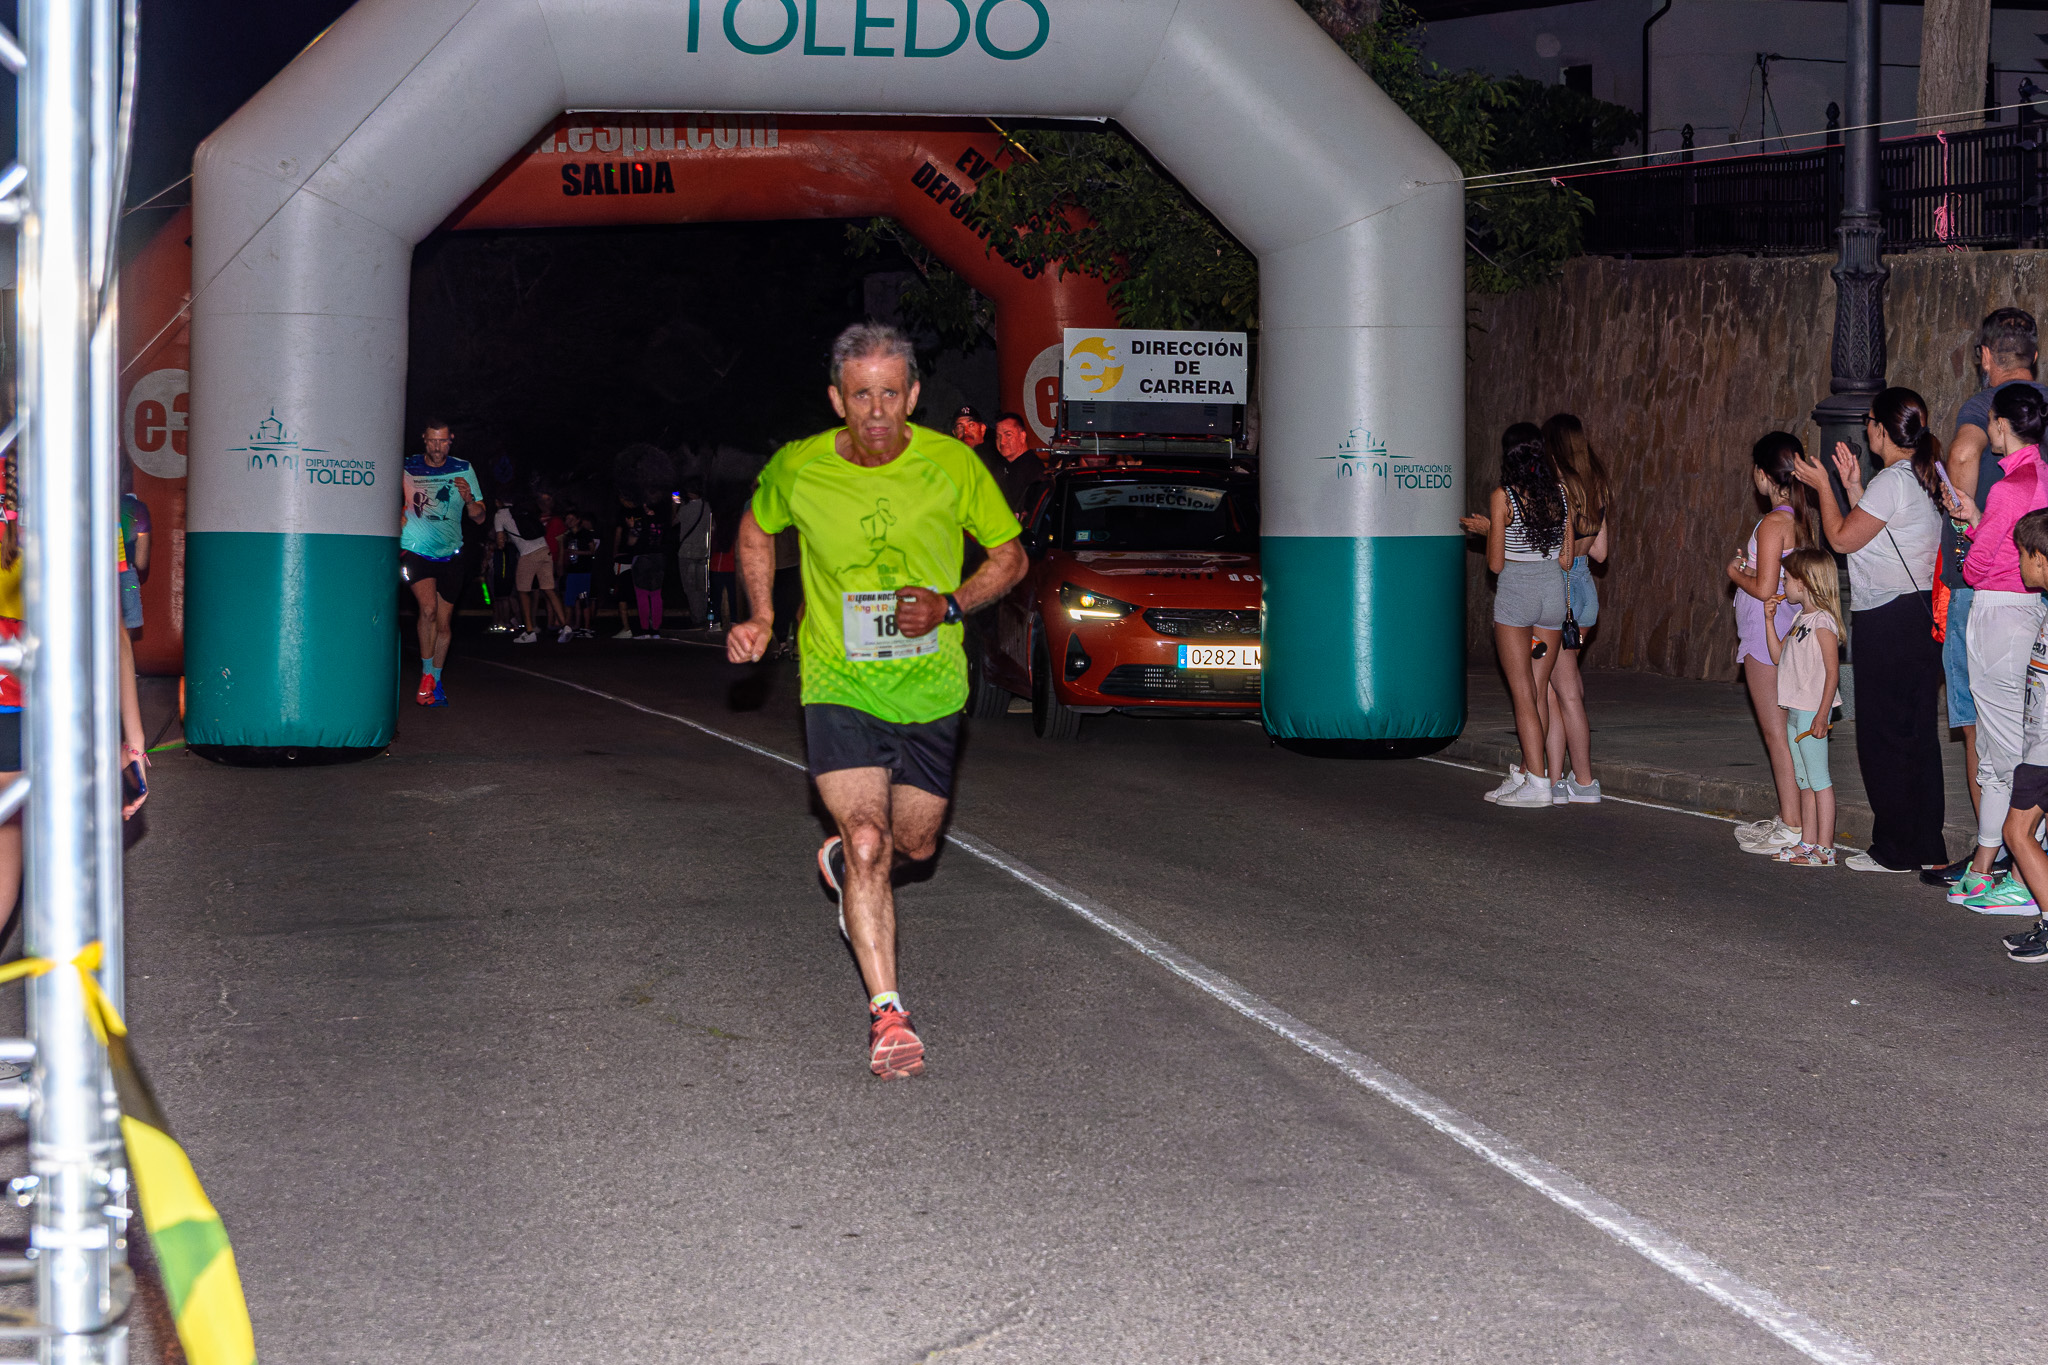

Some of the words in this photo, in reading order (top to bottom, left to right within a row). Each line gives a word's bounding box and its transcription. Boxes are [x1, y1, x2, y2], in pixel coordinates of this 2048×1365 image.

[561, 161, 676, 196] SALIDA
[1131, 338, 1243, 357] DIRECCIÓN
[1174, 361, 1201, 375] DE
[1139, 379, 1235, 395] CARRERA
[306, 459, 364, 469] DIPUTACIÓN
[365, 461, 376, 470] DE
[1394, 463, 1443, 473] DIPUTACIÓN
[1444, 465, 1452, 473] DE
[306, 469, 376, 486] TOLEDO
[1394, 474, 1452, 489] TOLEDO
[1191, 649, 1236, 665] 0282
